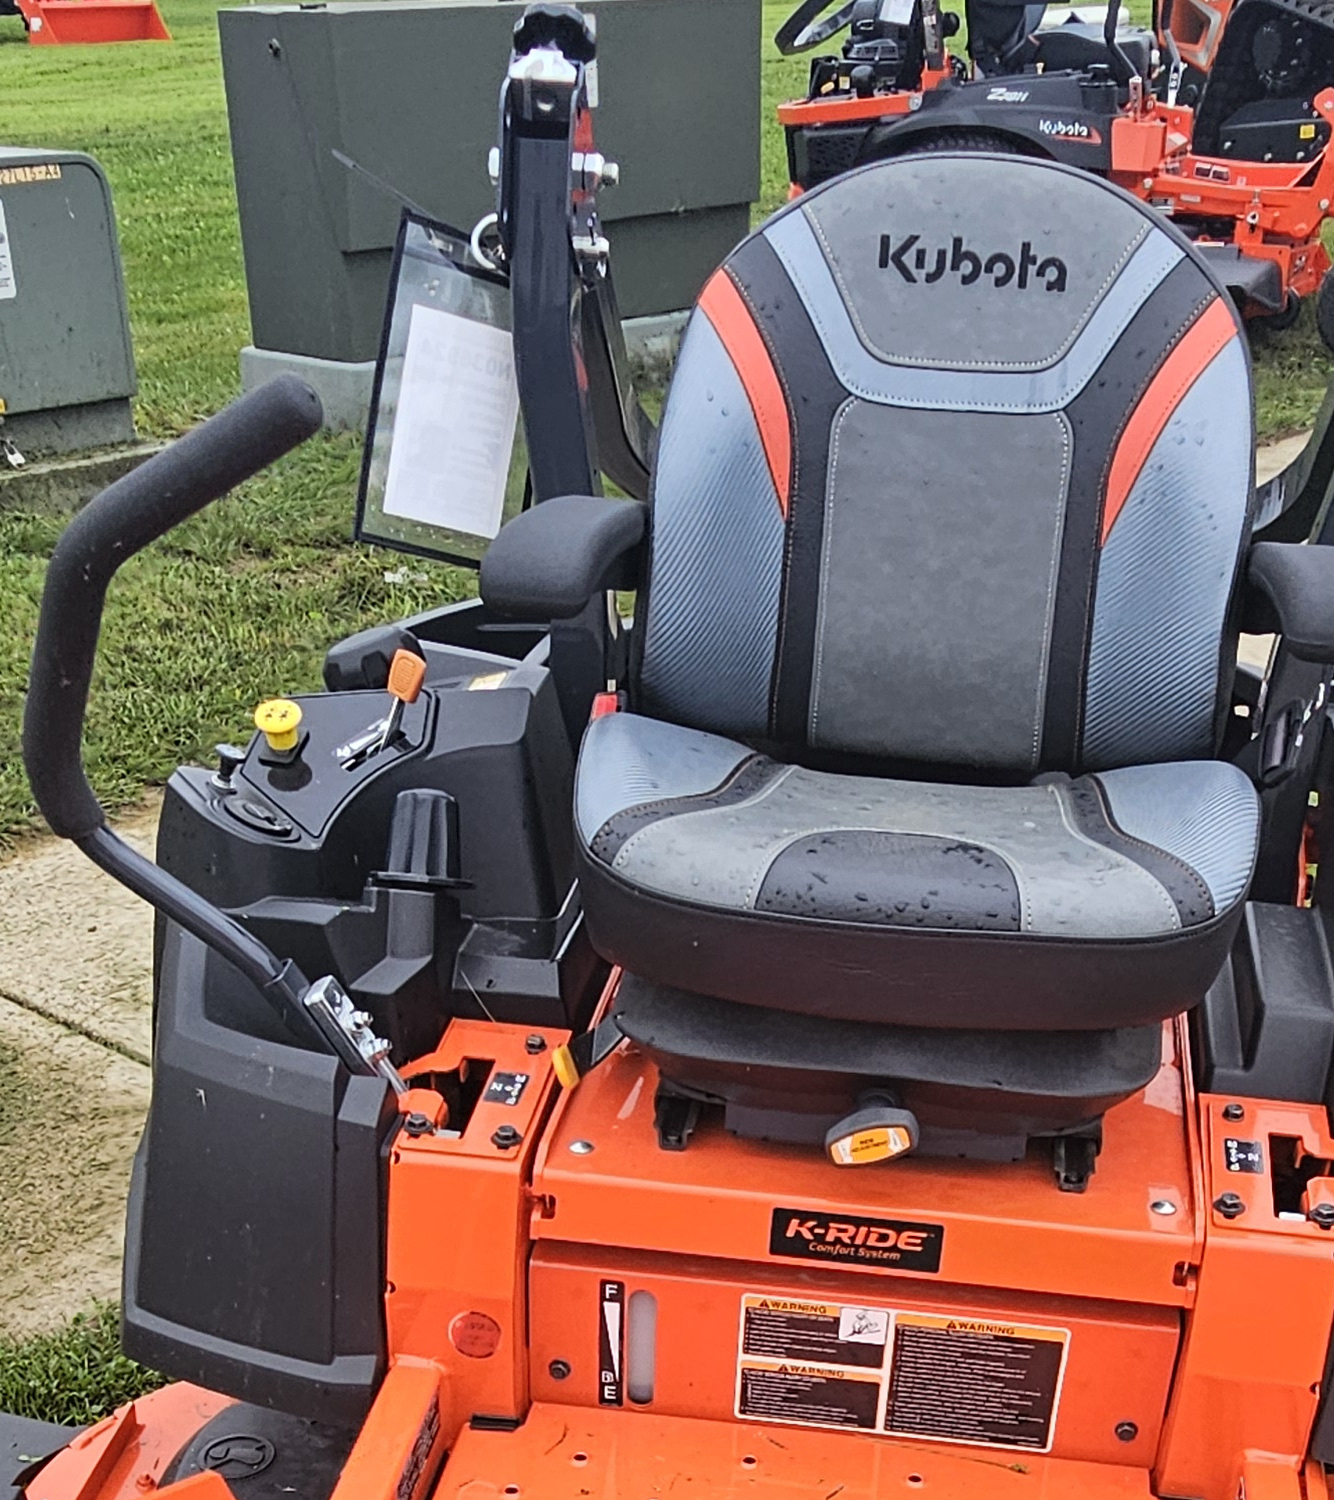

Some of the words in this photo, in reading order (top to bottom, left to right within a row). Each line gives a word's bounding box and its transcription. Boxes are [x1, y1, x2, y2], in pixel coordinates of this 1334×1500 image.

[1039, 119, 1088, 137] Kubota
[878, 234, 1068, 293] Kubota
[785, 1218, 929, 1252] K-RIDE
[808, 1242, 855, 1256] Comfort
[858, 1248, 901, 1261] System
[605, 1283, 618, 1299] F
[771, 1301, 827, 1314] WARNING
[958, 1321, 1016, 1335] WARNING
[790, 1366, 845, 1378] WARNING
[604, 1385, 617, 1399] E
